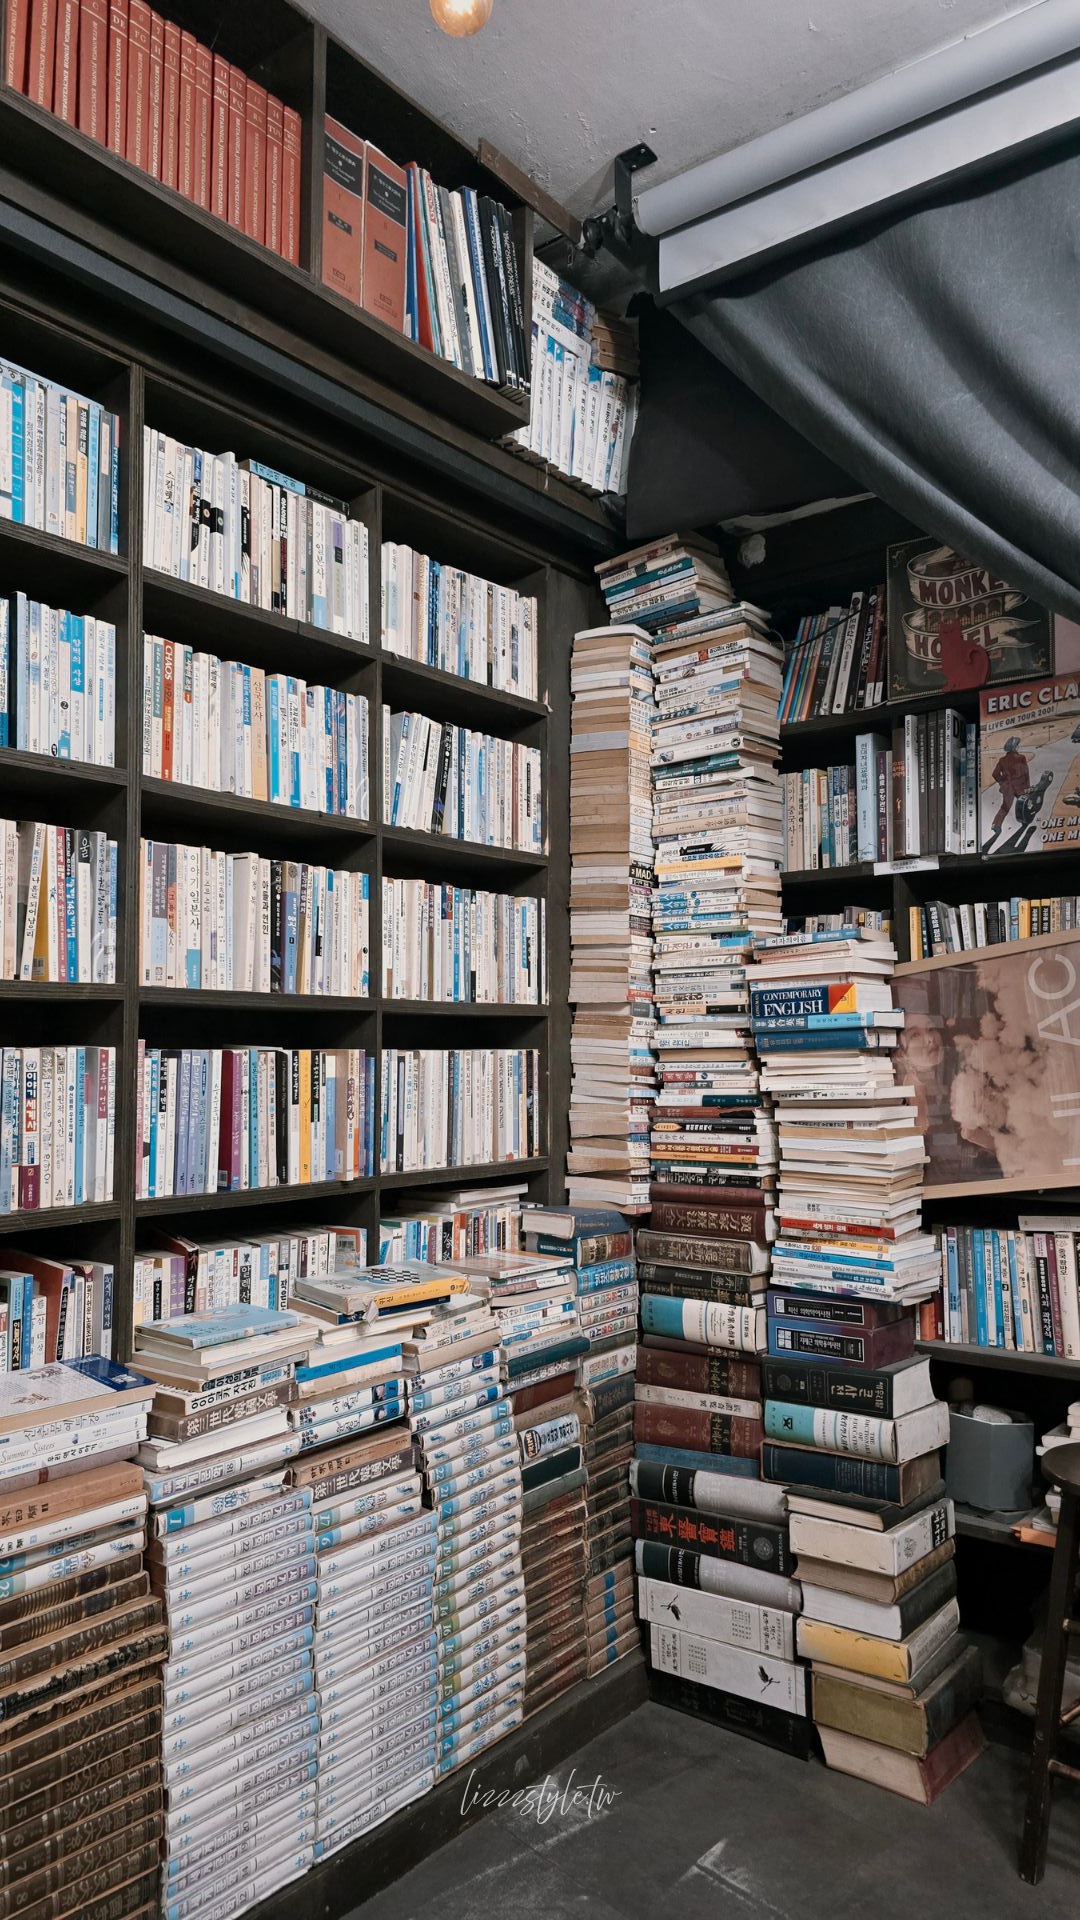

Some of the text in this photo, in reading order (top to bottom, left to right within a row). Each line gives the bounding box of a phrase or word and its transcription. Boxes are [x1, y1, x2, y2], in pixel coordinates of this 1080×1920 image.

[915, 627, 1000, 659] HOEL
[164, 645, 173, 680] CHAOS
[987, 680, 1080, 714] ERIC CLA
[988, 720, 1004, 731] LIVE
[1006, 717, 1017, 726] ON
[1018, 711, 1037, 723] TOUR
[1040, 830, 1061, 844] ONE
[67, 900, 75, 916] 143
[763, 988, 823, 1002] CONTEMPORARY
[763, 1000, 823, 1017] ENGLISH
[26, 1072, 37, 1098] 이야기
[26, 1098, 37, 1132] 세계사
[831, 1385, 874, 1399] 큰사전
[187, 1390, 279, 1437] 第三世代韓國文學
[858, 1432, 863, 1441] OF
[1, 1441, 55, 1463] Summer Sisters
[226, 1462, 234, 1473] 18
[314, 1455, 402, 1499] 第三世代韓國文學
[660, 1513, 736, 1550] 東醫寶鑑
